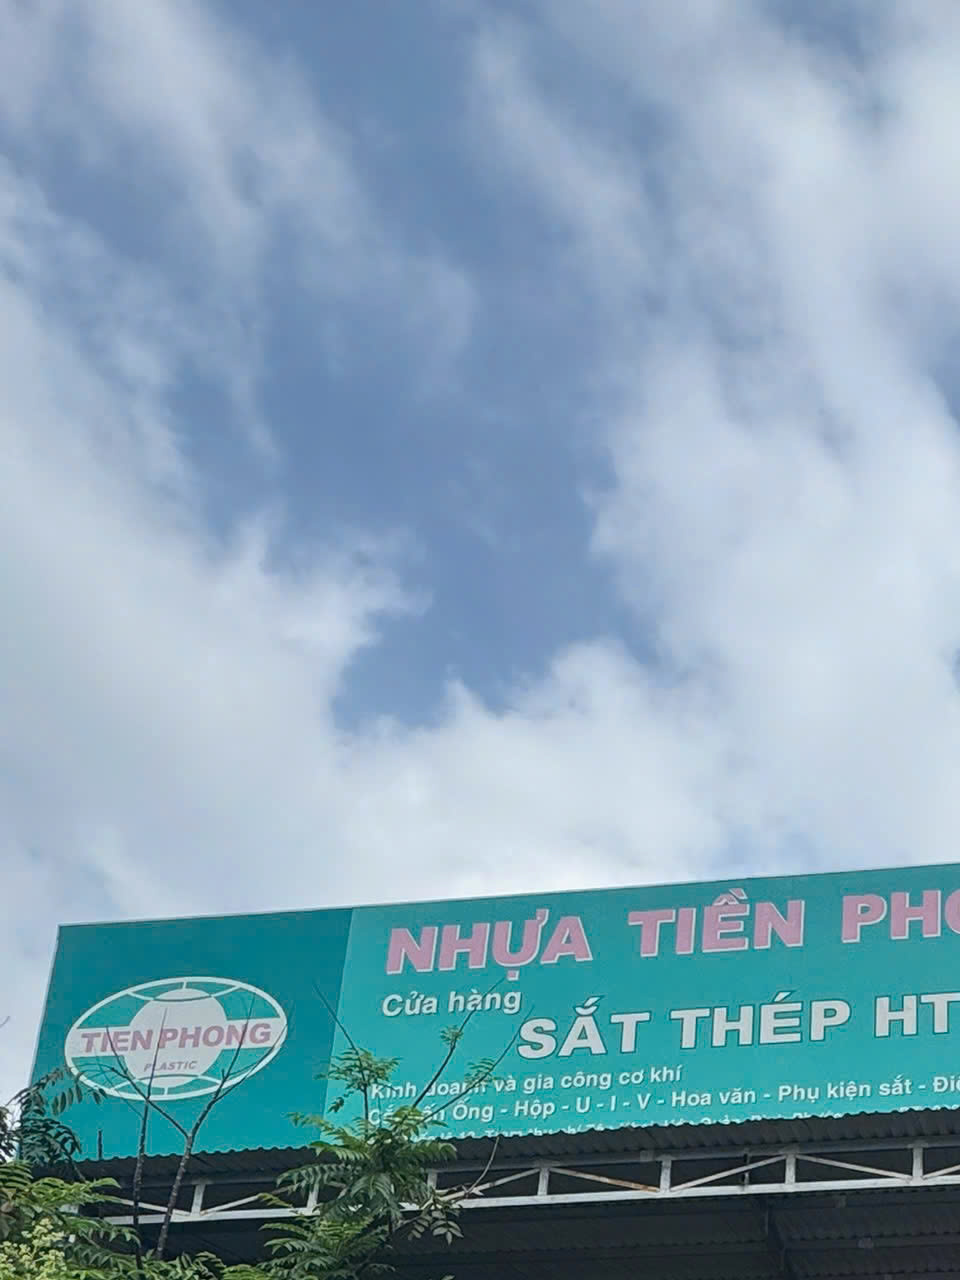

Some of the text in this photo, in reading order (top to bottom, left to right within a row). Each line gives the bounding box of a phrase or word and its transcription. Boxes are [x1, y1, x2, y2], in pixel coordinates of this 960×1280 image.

[385, 908, 593, 981] NHỰA
[628, 888, 805, 958] TIỀN
[381, 987, 522, 1018] Cửa hàng
[80, 1022, 272, 1054] TIEN PHONG
[517, 995, 651, 1060] SẮT
[670, 990, 851, 1050] THÉP
[143, 1060, 198, 1073] PLASTIC
[494, 1074, 517, 1093] và
[523, 1074, 554, 1095] gia
[560, 1072, 611, 1091] công
[618, 1068, 644, 1085] cơ
[650, 1064, 683, 1083] khí
[452, 1096, 494, 1122] Ống
[514, 1099, 556, 1120] Hộp
[575, 1096, 591, 1114] U
[609, 1094, 617, 1112] I
[637, 1093, 651, 1110] V
[670, 1090, 712, 1108] Hoa
[719, 1087, 756, 1105] văn
[777, 1083, 820, 1104] Phụ
[827, 1079, 871, 1102] kiện
[879, 1074, 912, 1097] sắt
